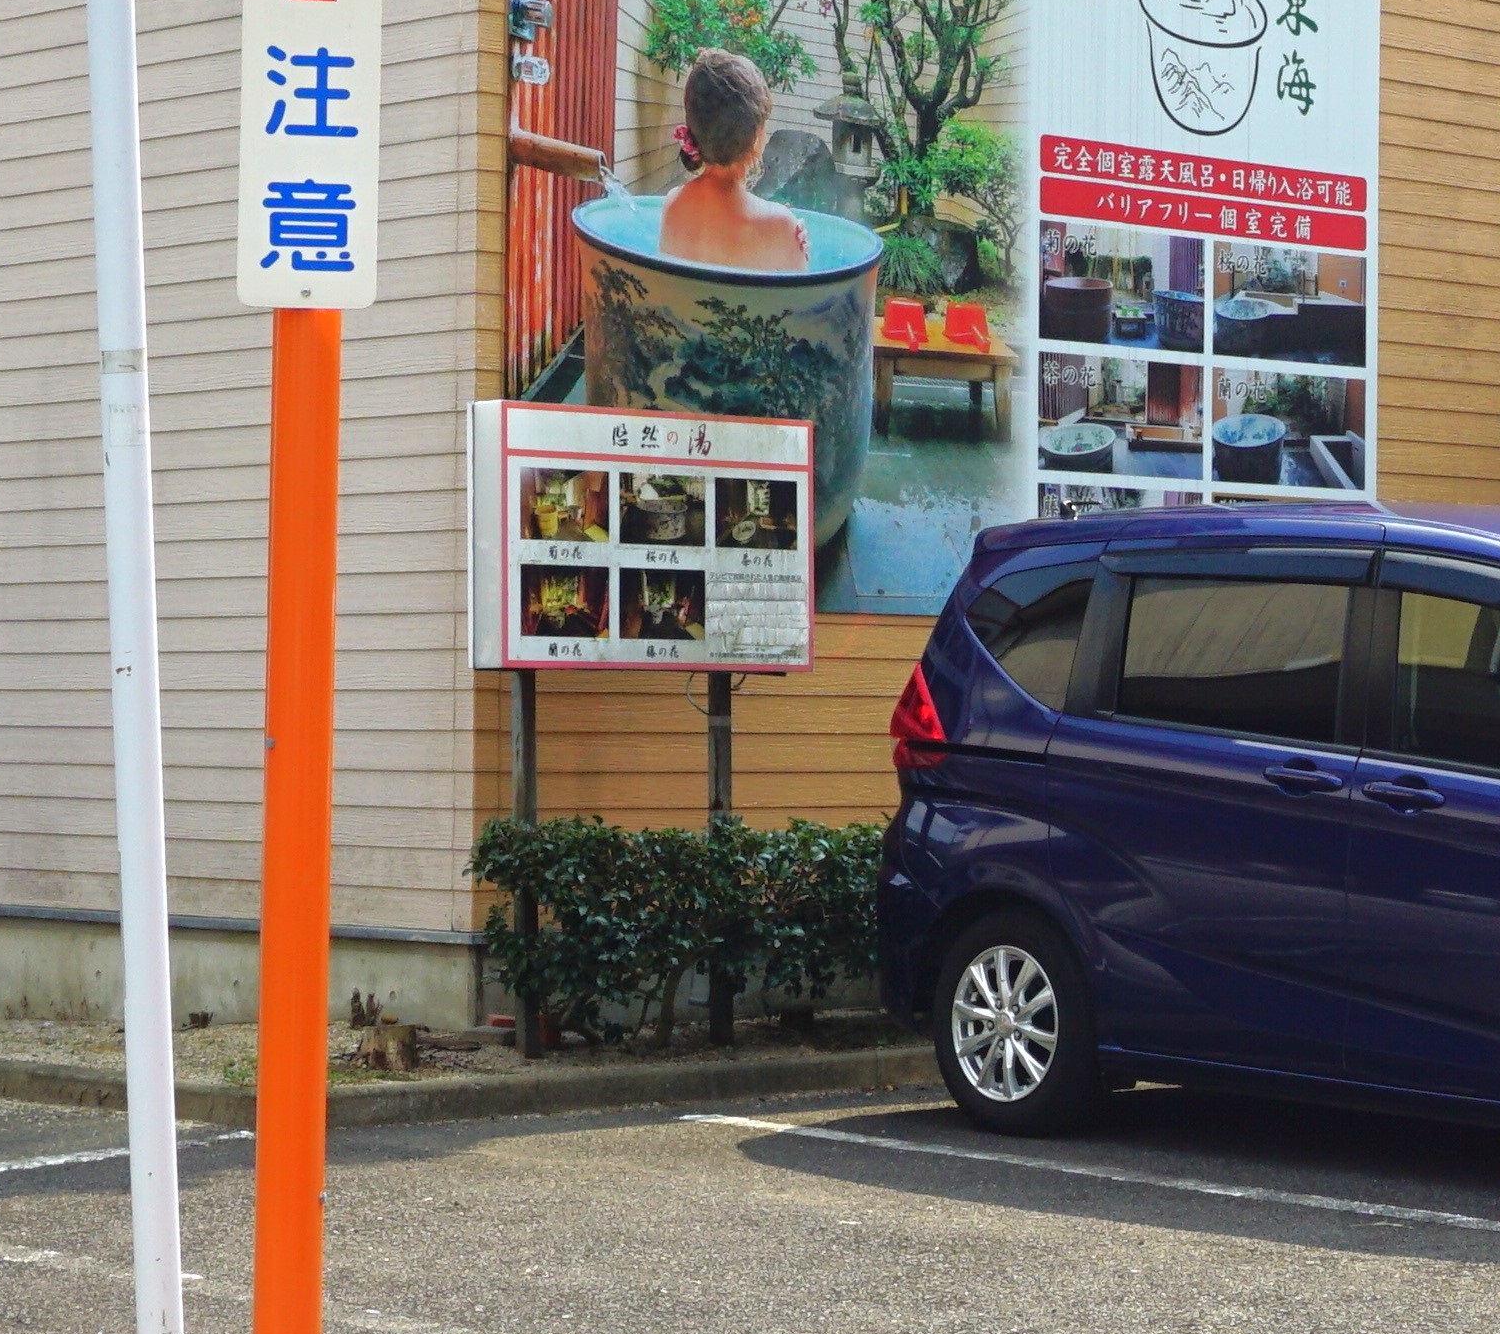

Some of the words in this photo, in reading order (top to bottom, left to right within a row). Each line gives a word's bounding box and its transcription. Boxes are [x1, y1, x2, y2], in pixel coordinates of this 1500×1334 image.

[260, 45, 359, 271] 注意
[1097, 194, 1312, 241] バリアフリー個室完備
[1045, 229, 1097, 256] 菊の花
[1217, 249, 1268, 276] 桜の花
[1043, 361, 1098, 388] 茶の花
